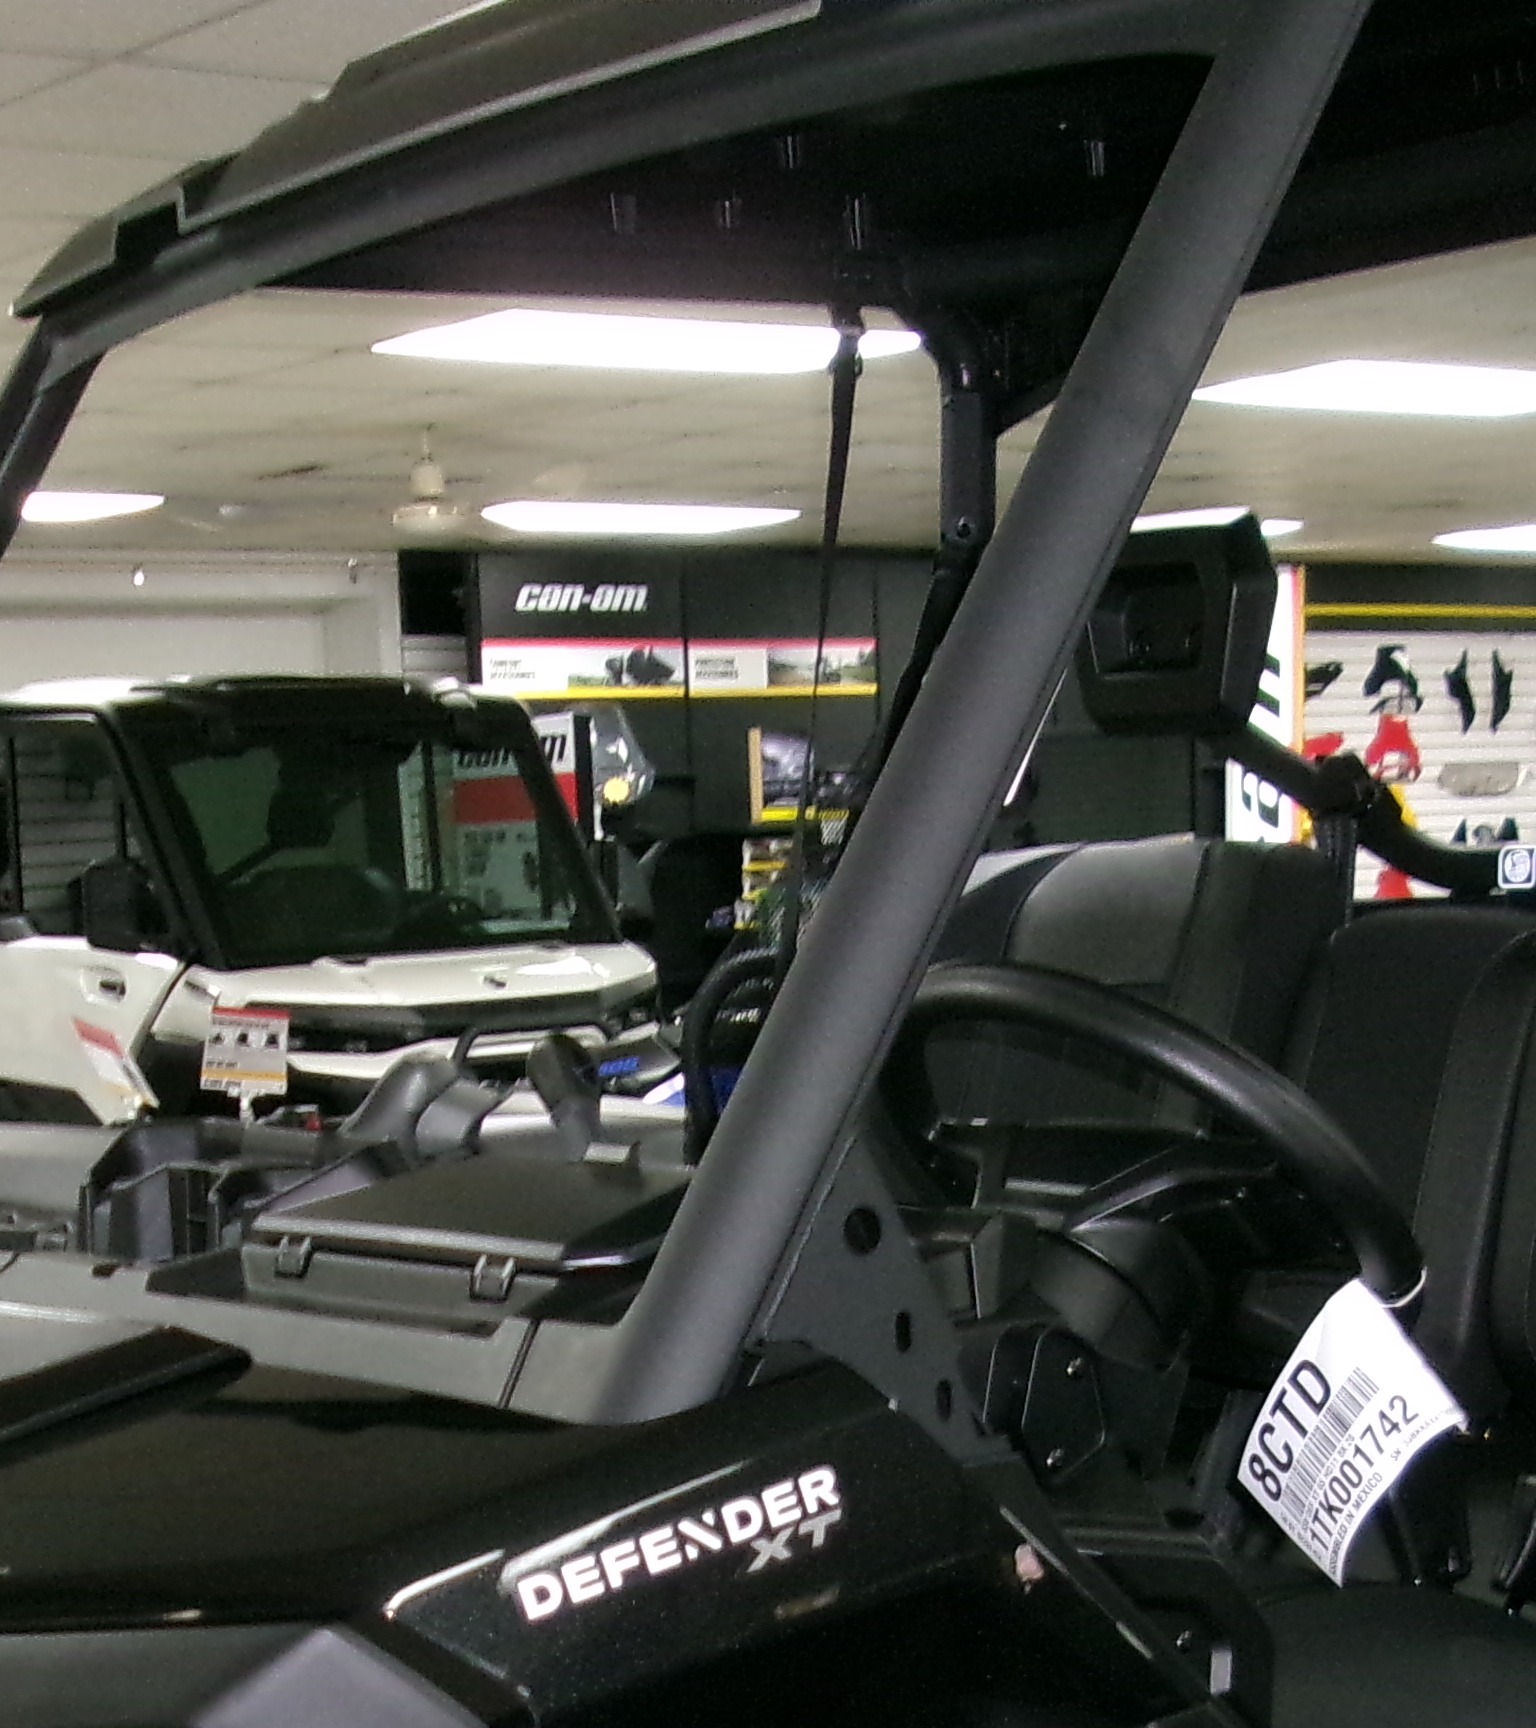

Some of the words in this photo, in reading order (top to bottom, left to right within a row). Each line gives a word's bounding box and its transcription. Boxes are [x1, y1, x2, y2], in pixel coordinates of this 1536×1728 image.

[1248, 1359, 1332, 1502] 8CTD
[1309, 1394, 1420, 1552] 1TK001742
[1351, 1471, 1383, 1513] MEXICO
[516, 1463, 840, 1622] DEFENDER
[747, 1508, 842, 1573] XT
